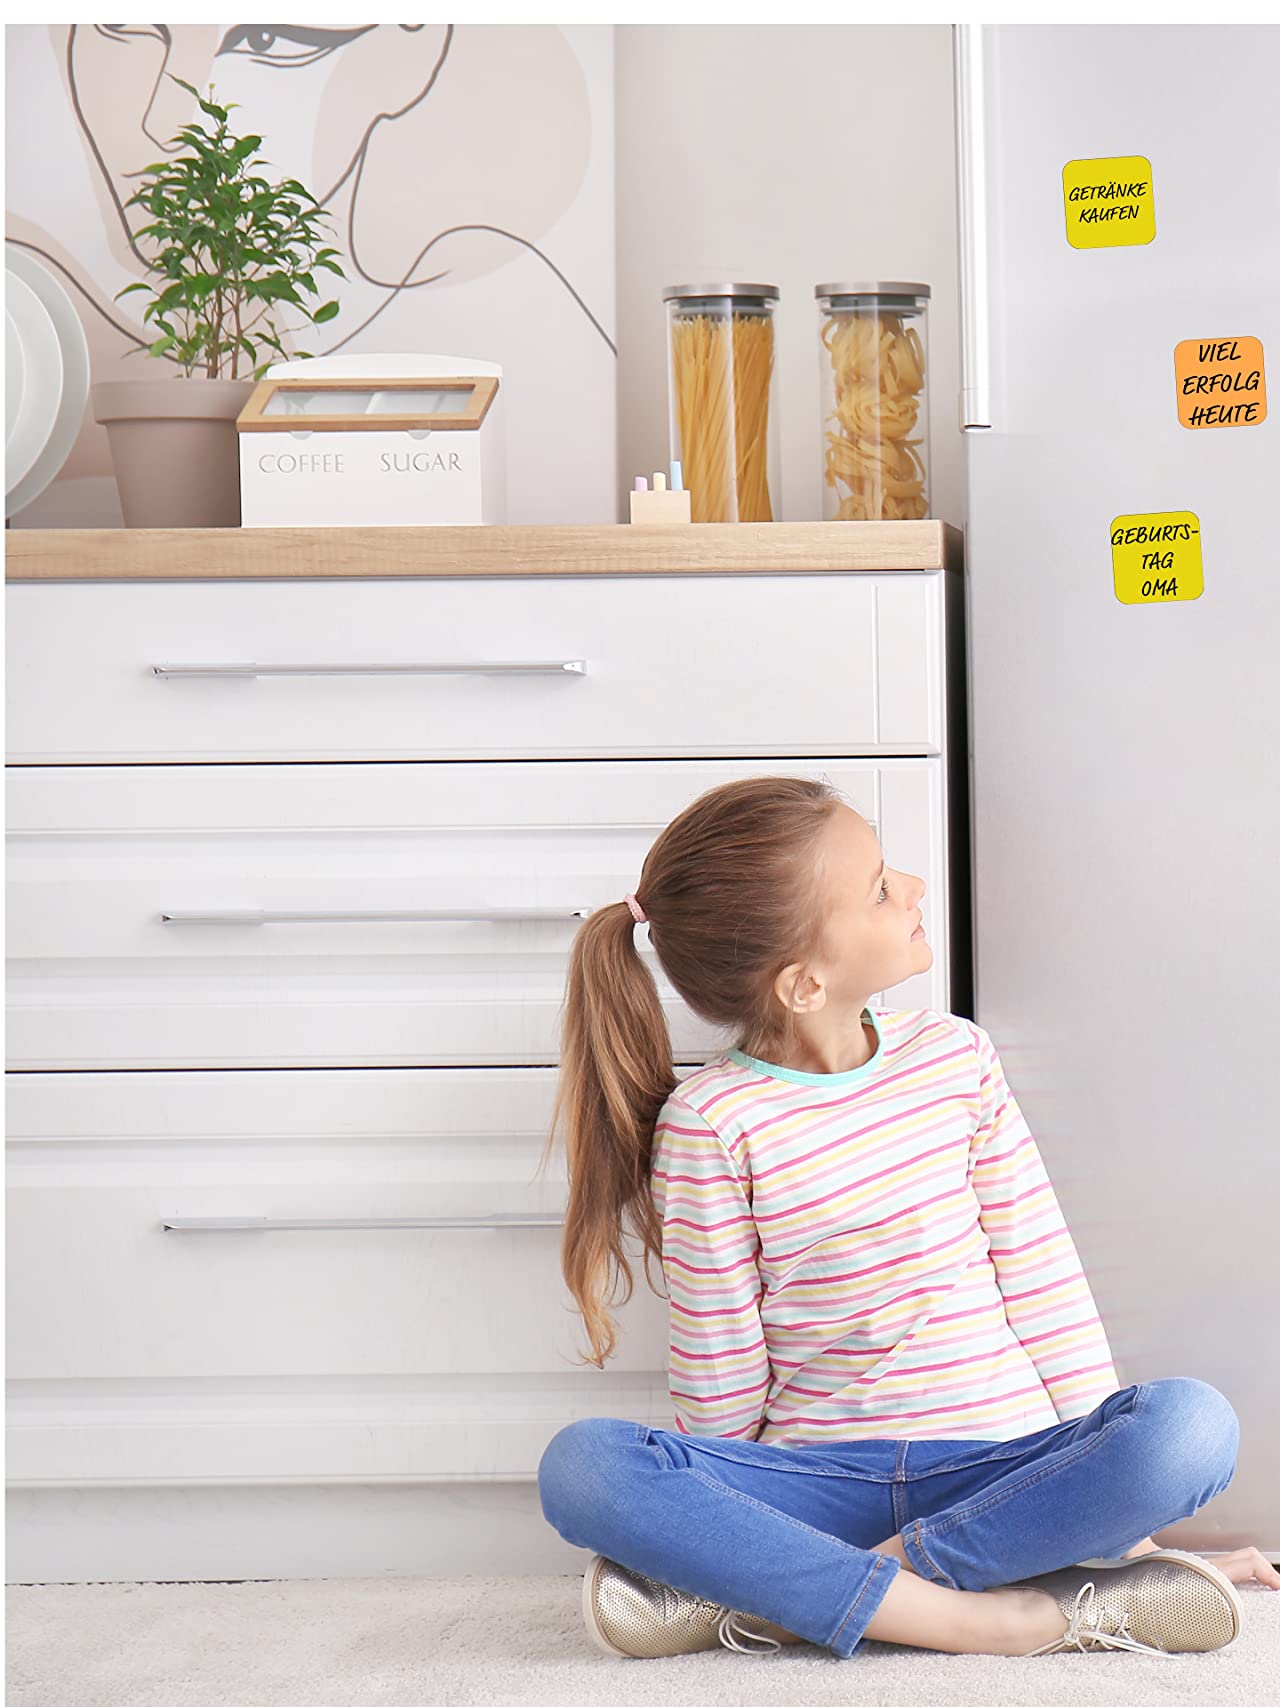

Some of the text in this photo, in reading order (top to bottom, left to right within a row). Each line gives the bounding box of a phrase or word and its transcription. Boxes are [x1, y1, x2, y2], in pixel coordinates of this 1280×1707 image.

[1068, 181, 1149, 202] GETRÄNKE
[1078, 204, 1140, 224] KAUFEN
[1198, 341, 1242, 363] VIEL
[1182, 370, 1261, 396] ERFOLG
[1188, 402, 1260, 427] HEUTE
[258, 453, 345, 474] COFFEE
[380, 452, 462, 472] SUGAR
[1110, 523, 1200, 546] GEBURTS-
[1141, 551, 1174, 570] TAG
[1141, 577, 1179, 597] OMA
